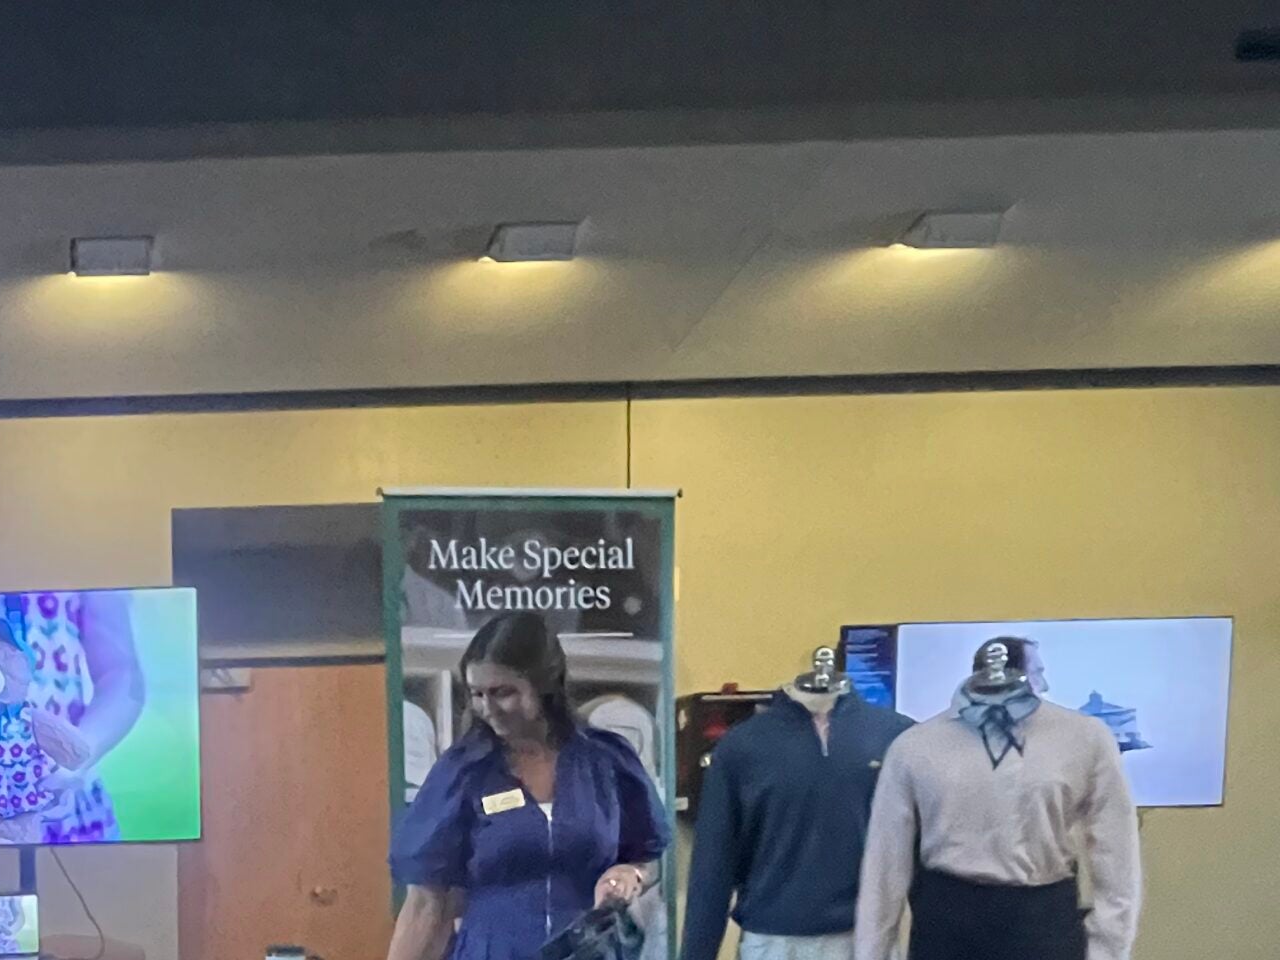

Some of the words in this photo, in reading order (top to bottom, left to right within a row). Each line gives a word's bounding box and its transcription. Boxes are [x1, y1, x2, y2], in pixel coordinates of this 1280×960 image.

[428, 537, 515, 570] Make
[523, 537, 635, 578] Special
[454, 579, 612, 610] Memories
